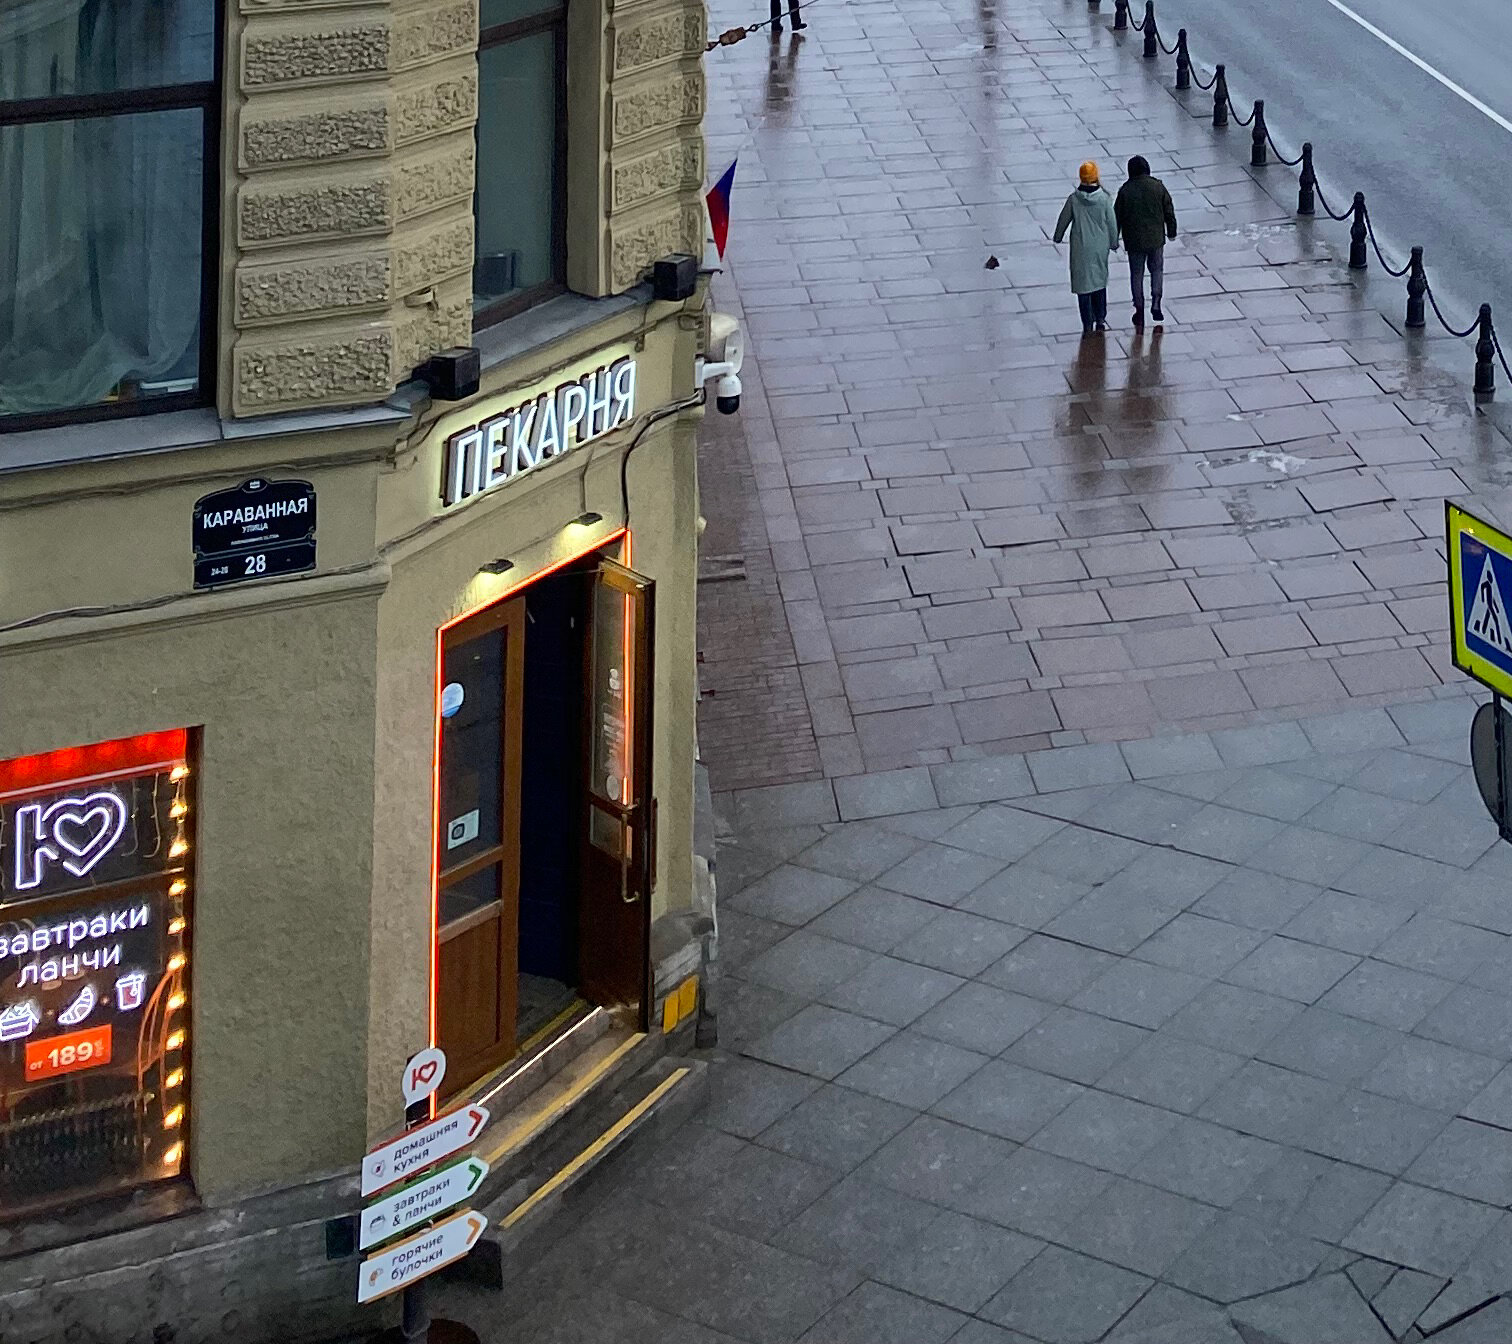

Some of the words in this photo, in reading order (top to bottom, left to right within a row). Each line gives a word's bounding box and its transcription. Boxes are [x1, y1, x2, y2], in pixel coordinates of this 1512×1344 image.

[449, 358, 637, 505] ПЕКАРНЯ
[203, 497, 308, 529] КАРАВАННАЯ
[241, 522, 269, 534] УЛИЦА
[244, 554, 267, 575] 28
[16, 944, 122, 989] ланчи
[29, 1060, 43, 1071] от
[47, 1041, 94, 1068] 189
[393, 1119, 459, 1162] домашняя
[393, 1148, 430, 1174] кухня
[392, 1214, 401, 1227] &
[404, 1196, 443, 1223] ланчи
[393, 1177, 451, 1213] завтраки
[390, 1247, 443, 1281] булочки
[391, 1233, 444, 1267] горячие
